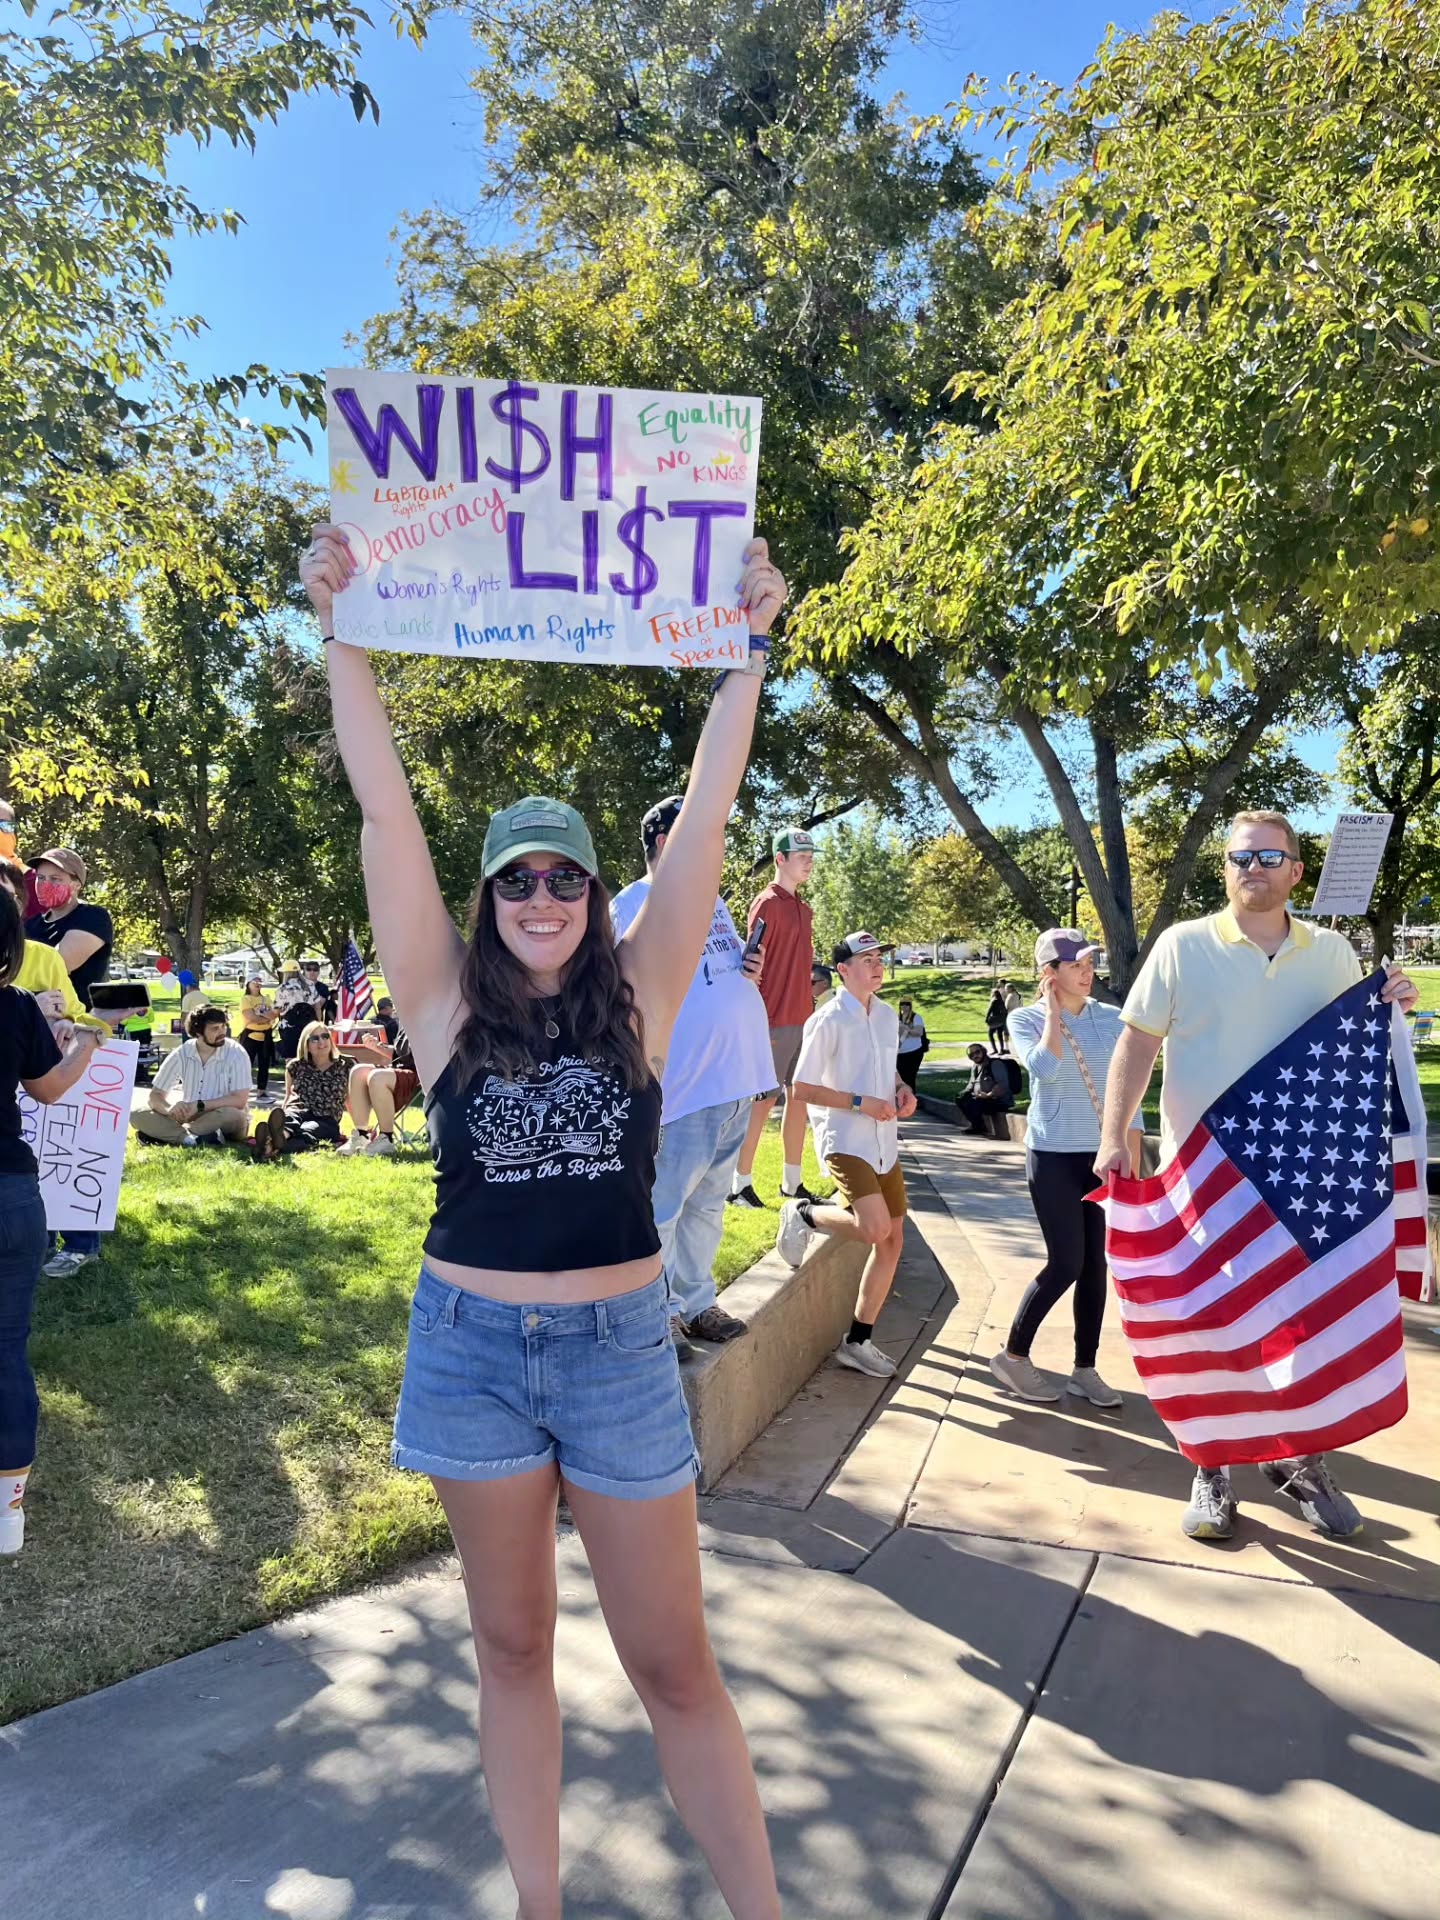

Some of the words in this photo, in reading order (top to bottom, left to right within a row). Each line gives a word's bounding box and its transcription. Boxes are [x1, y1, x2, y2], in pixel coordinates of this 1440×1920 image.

[637, 399, 760, 454] Equality
[657, 450, 691, 473] NO
[693, 464, 748, 483] KINGS
[374, 484, 455, 503] LGBTQIA+
[392, 502, 428, 520] Rights
[335, 487, 510, 576] Democracy
[376, 572, 448, 599] Women's
[452, 573, 502, 606] Rights
[384, 613, 434, 636] Lands
[454, 620, 535, 649] Human
[546, 615, 616, 653] Rights
[648, 606, 750, 643] FREEDOM
[1339, 815, 1374, 825] FASCISM
[712, 938, 730, 953] the
[40, 1103, 79, 1185] FEAR
[484, 1167, 532, 1182] Curse
[536, 1160, 563, 1178] the
[567, 1155, 624, 1180] Bigots
[70, 1147, 110, 1224] NOT
